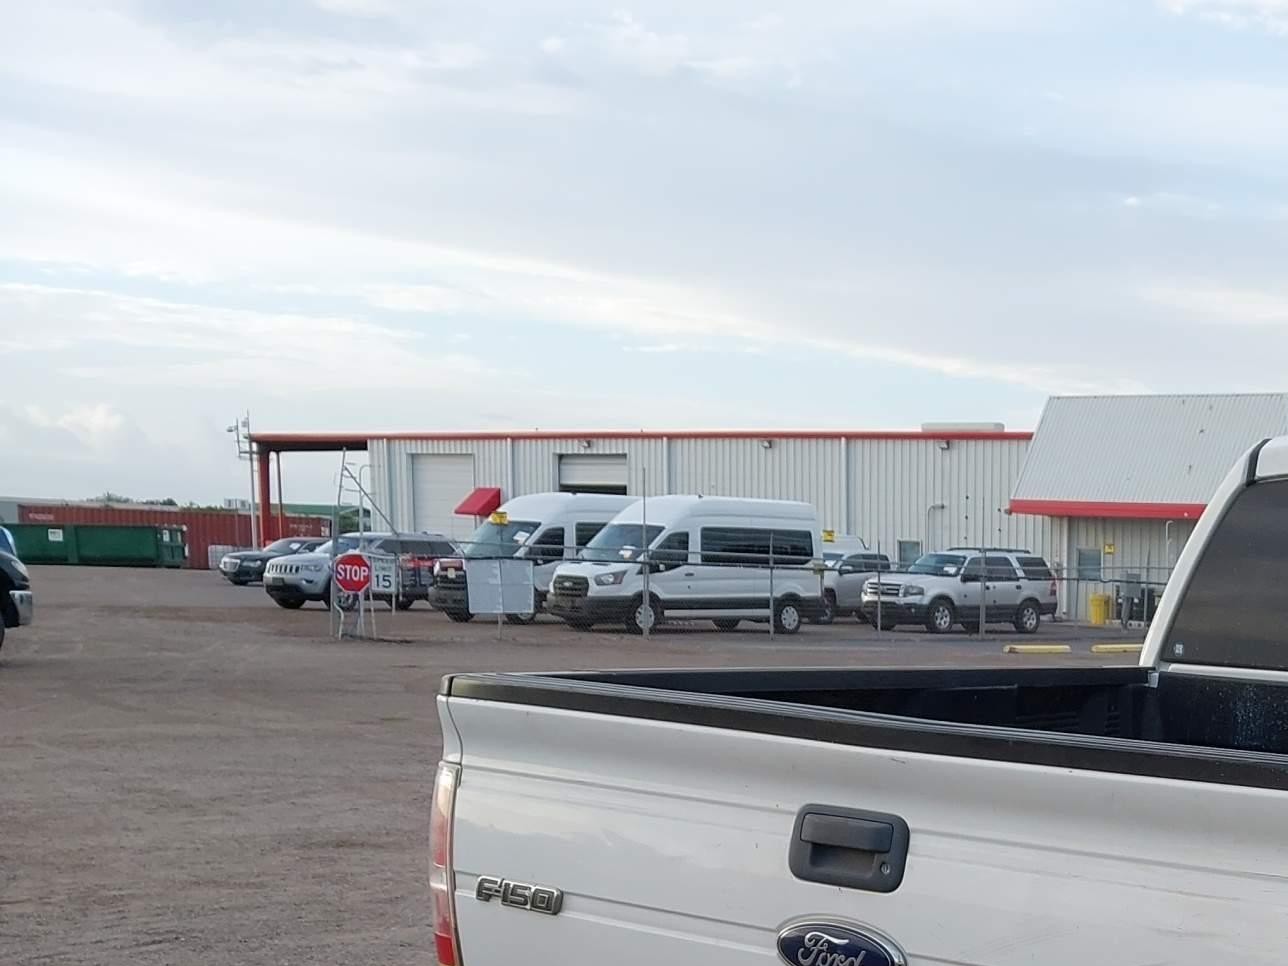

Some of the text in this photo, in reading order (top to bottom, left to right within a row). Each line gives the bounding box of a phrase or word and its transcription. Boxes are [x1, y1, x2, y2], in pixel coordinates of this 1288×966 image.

[337, 564, 369, 582] STOP
[375, 574, 392, 589] 15
[477, 876, 562, 914] F-150
